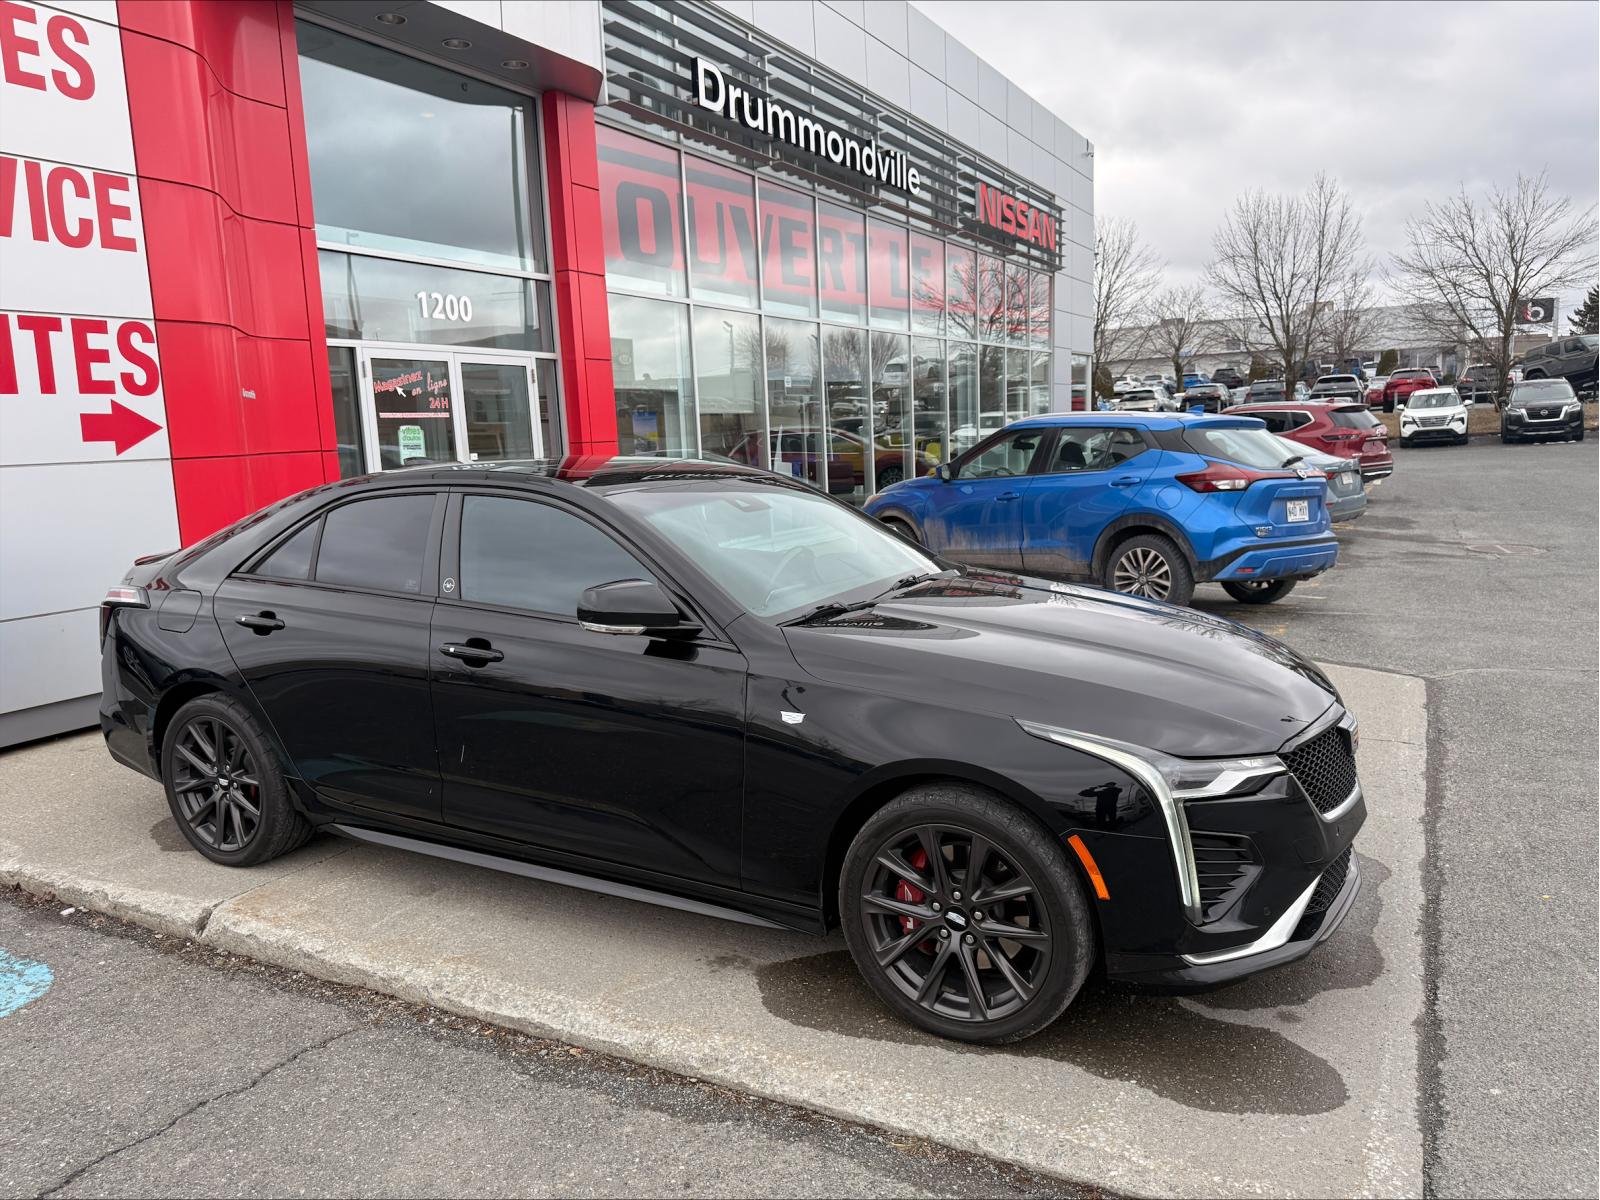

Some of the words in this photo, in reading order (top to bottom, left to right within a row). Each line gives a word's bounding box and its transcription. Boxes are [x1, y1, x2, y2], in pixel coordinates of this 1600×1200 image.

[696, 57, 921, 195] Drummondville
[616, 181, 873, 293] OUVERT
[889, 241, 932, 302] LE
[977, 182, 1056, 250] NISSAN
[416, 291, 473, 322] 1200
[426, 371, 448, 394] ligne
